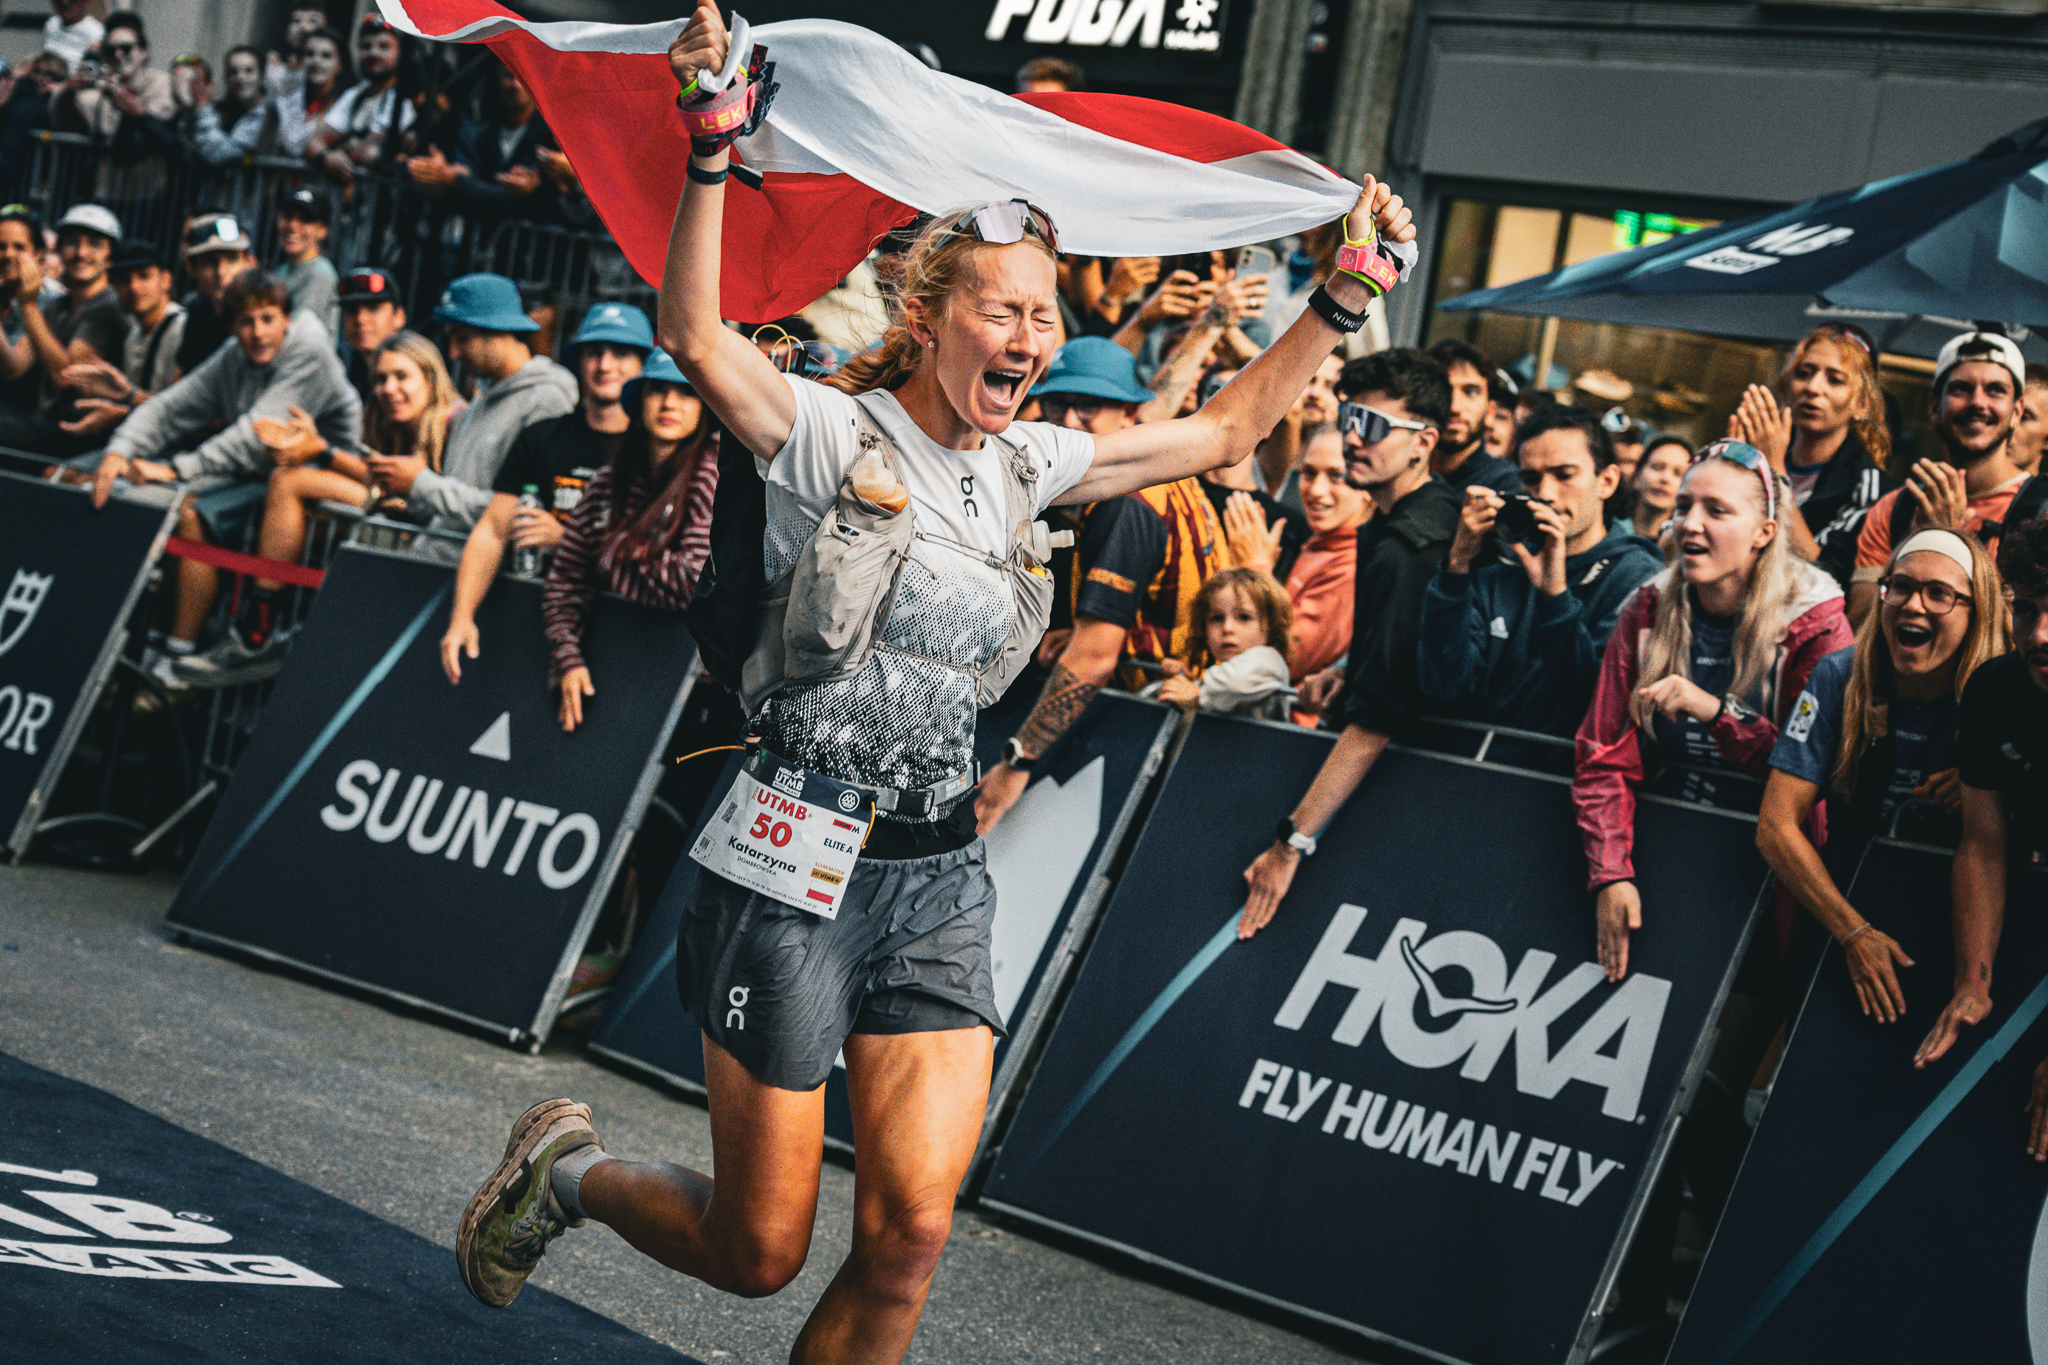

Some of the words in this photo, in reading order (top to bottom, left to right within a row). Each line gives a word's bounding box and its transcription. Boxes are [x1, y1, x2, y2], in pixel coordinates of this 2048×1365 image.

[701, 103, 746, 130] LEKI
[1368, 258, 1398, 288] LEK
[775, 773, 804, 791] UTMB
[757, 788, 808, 821] UTMB
[320, 758, 601, 890] SUUNTO
[749, 812, 793, 848] 50
[728, 835, 797, 874] Katarzyna
[823, 837, 845, 852] ELITE
[845, 845, 854, 855] A
[814, 861, 845, 876] SUMMITER
[1273, 902, 1673, 1122] HOKA
[1238, 1058, 1332, 1123] FLY
[1321, 1082, 1522, 1184] HUMAN
[1512, 1137, 1622, 1208] FLY
